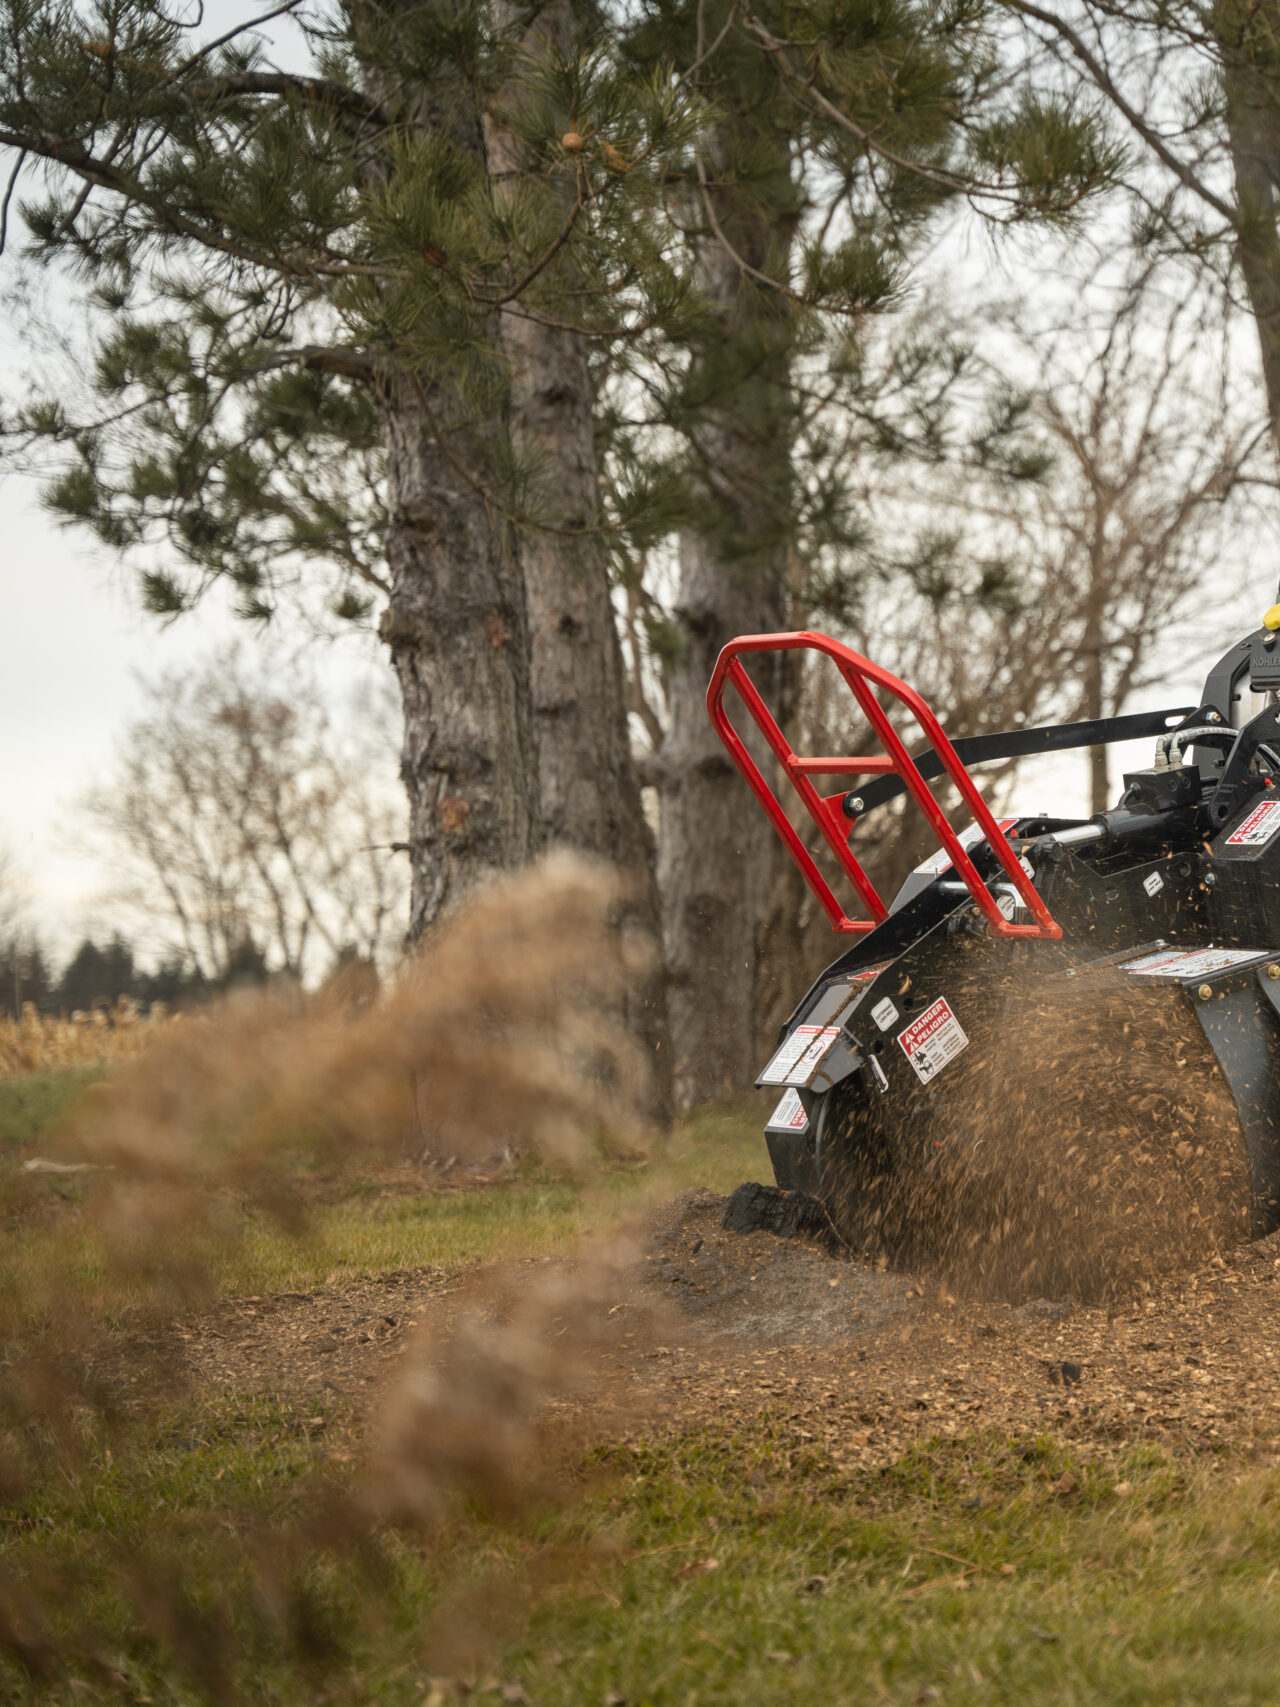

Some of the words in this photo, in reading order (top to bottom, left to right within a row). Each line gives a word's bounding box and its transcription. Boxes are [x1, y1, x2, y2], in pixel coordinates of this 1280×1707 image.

[1239, 804, 1267, 832] DANGER
[911, 1003, 944, 1035] DANGER
[916, 1011, 949, 1043] PELIGRO
